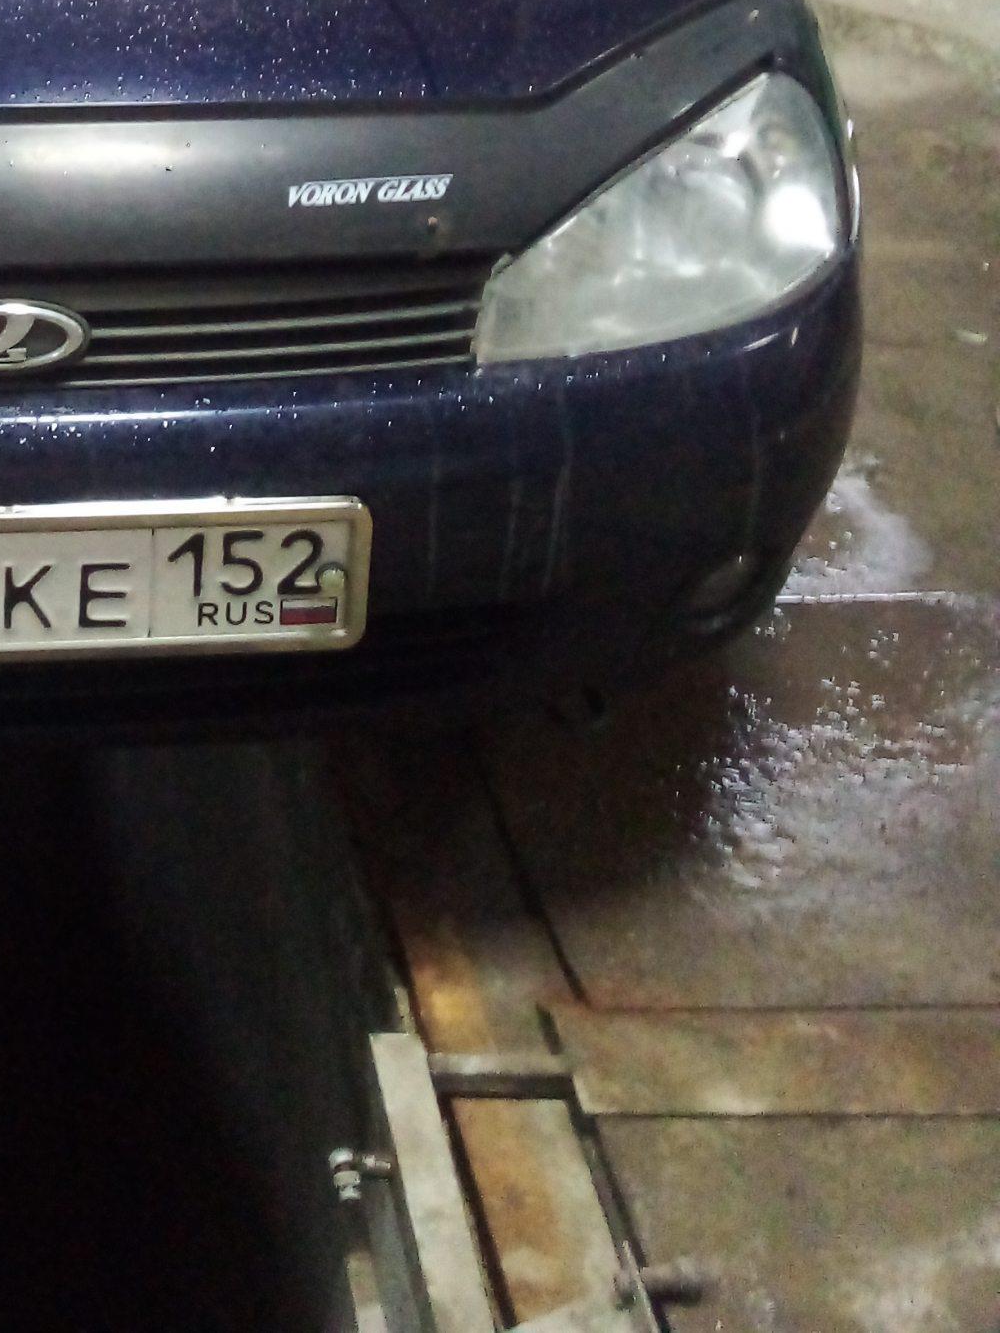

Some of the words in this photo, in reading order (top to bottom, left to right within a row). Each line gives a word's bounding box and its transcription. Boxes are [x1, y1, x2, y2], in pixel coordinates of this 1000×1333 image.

[288, 180, 375, 208] VORON
[377, 176, 452, 203] GLASS
[168, 528, 326, 597] 152
[198, 600, 275, 627] RUS
